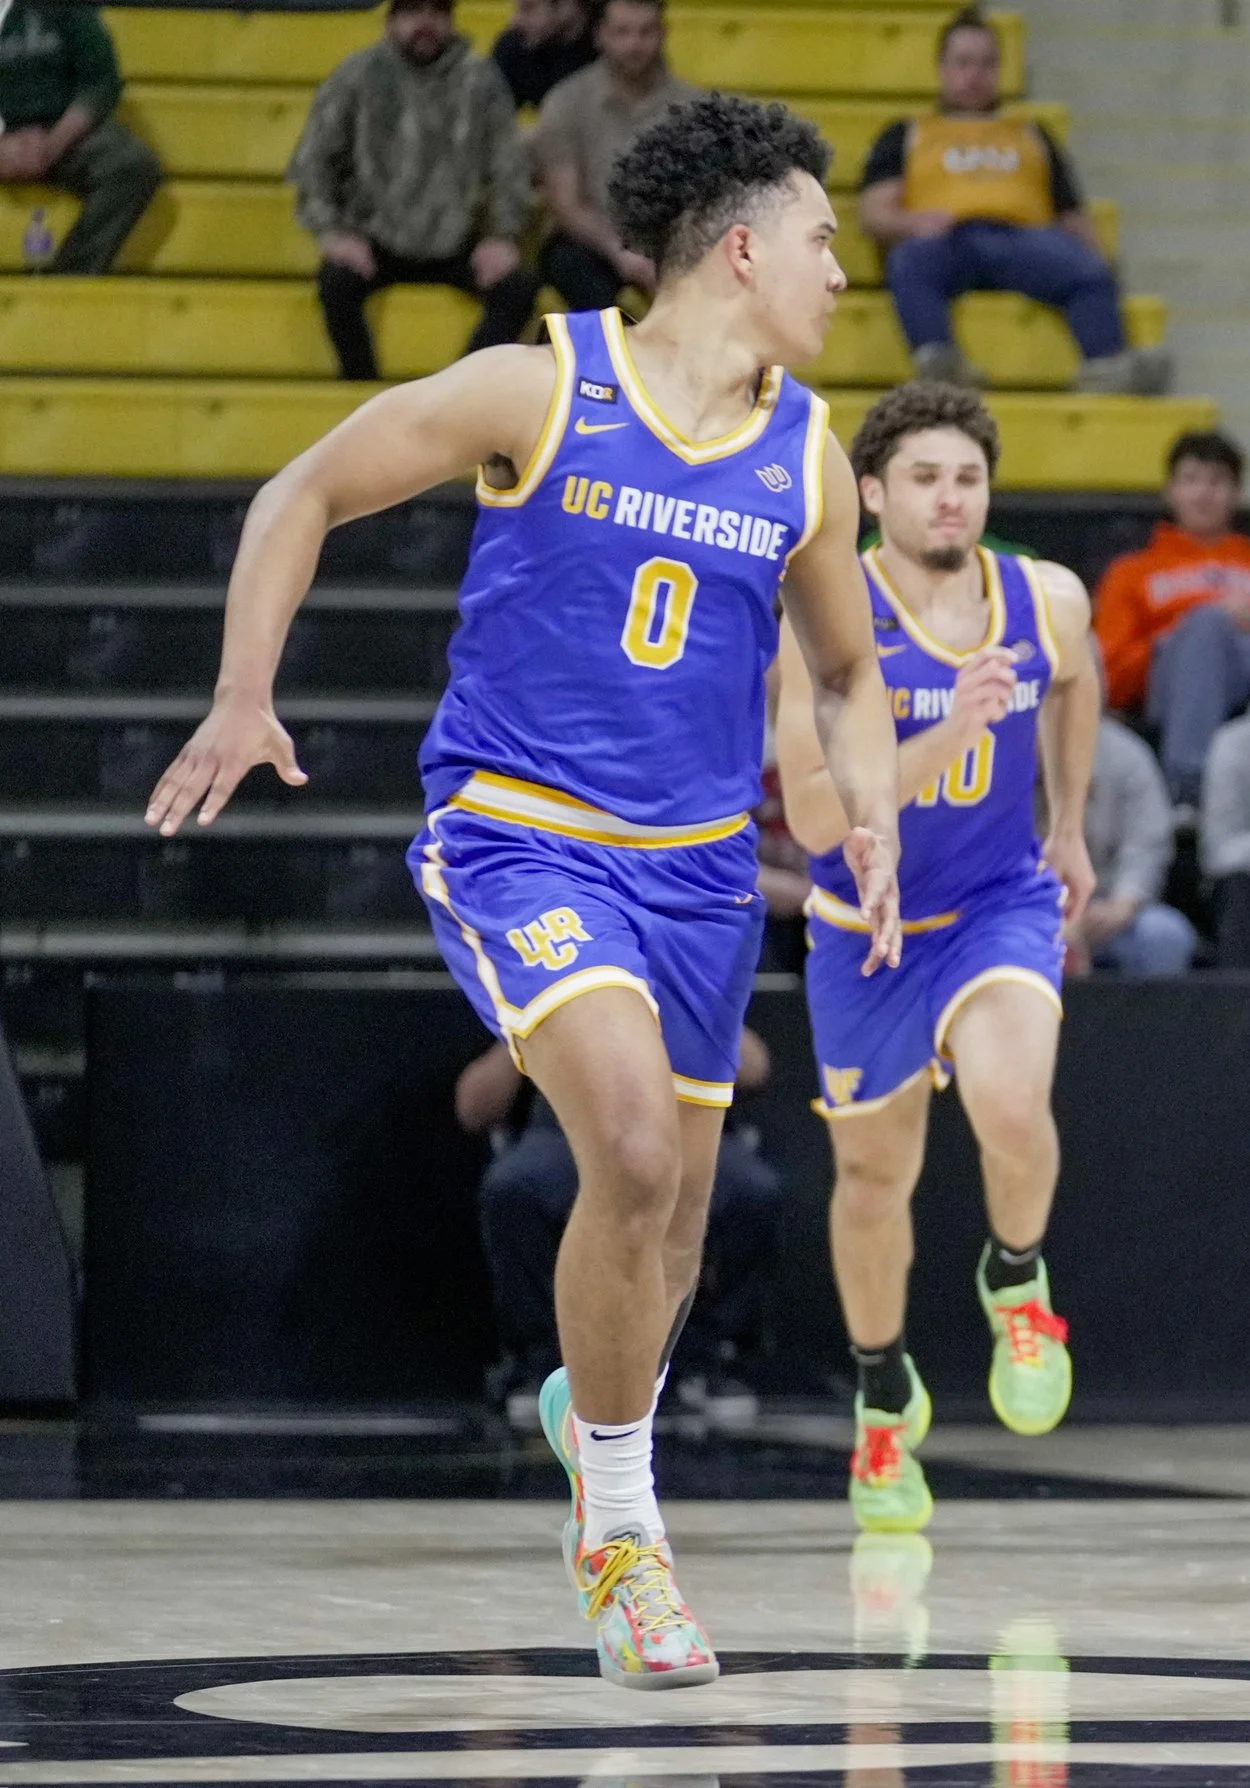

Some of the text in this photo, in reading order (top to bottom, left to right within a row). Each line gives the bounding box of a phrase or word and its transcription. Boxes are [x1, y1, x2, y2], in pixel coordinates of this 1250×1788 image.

[561, 475, 789, 560] UC RIVERSIDE
[620, 556, 699, 670] 0
[887, 687, 911, 719] C
